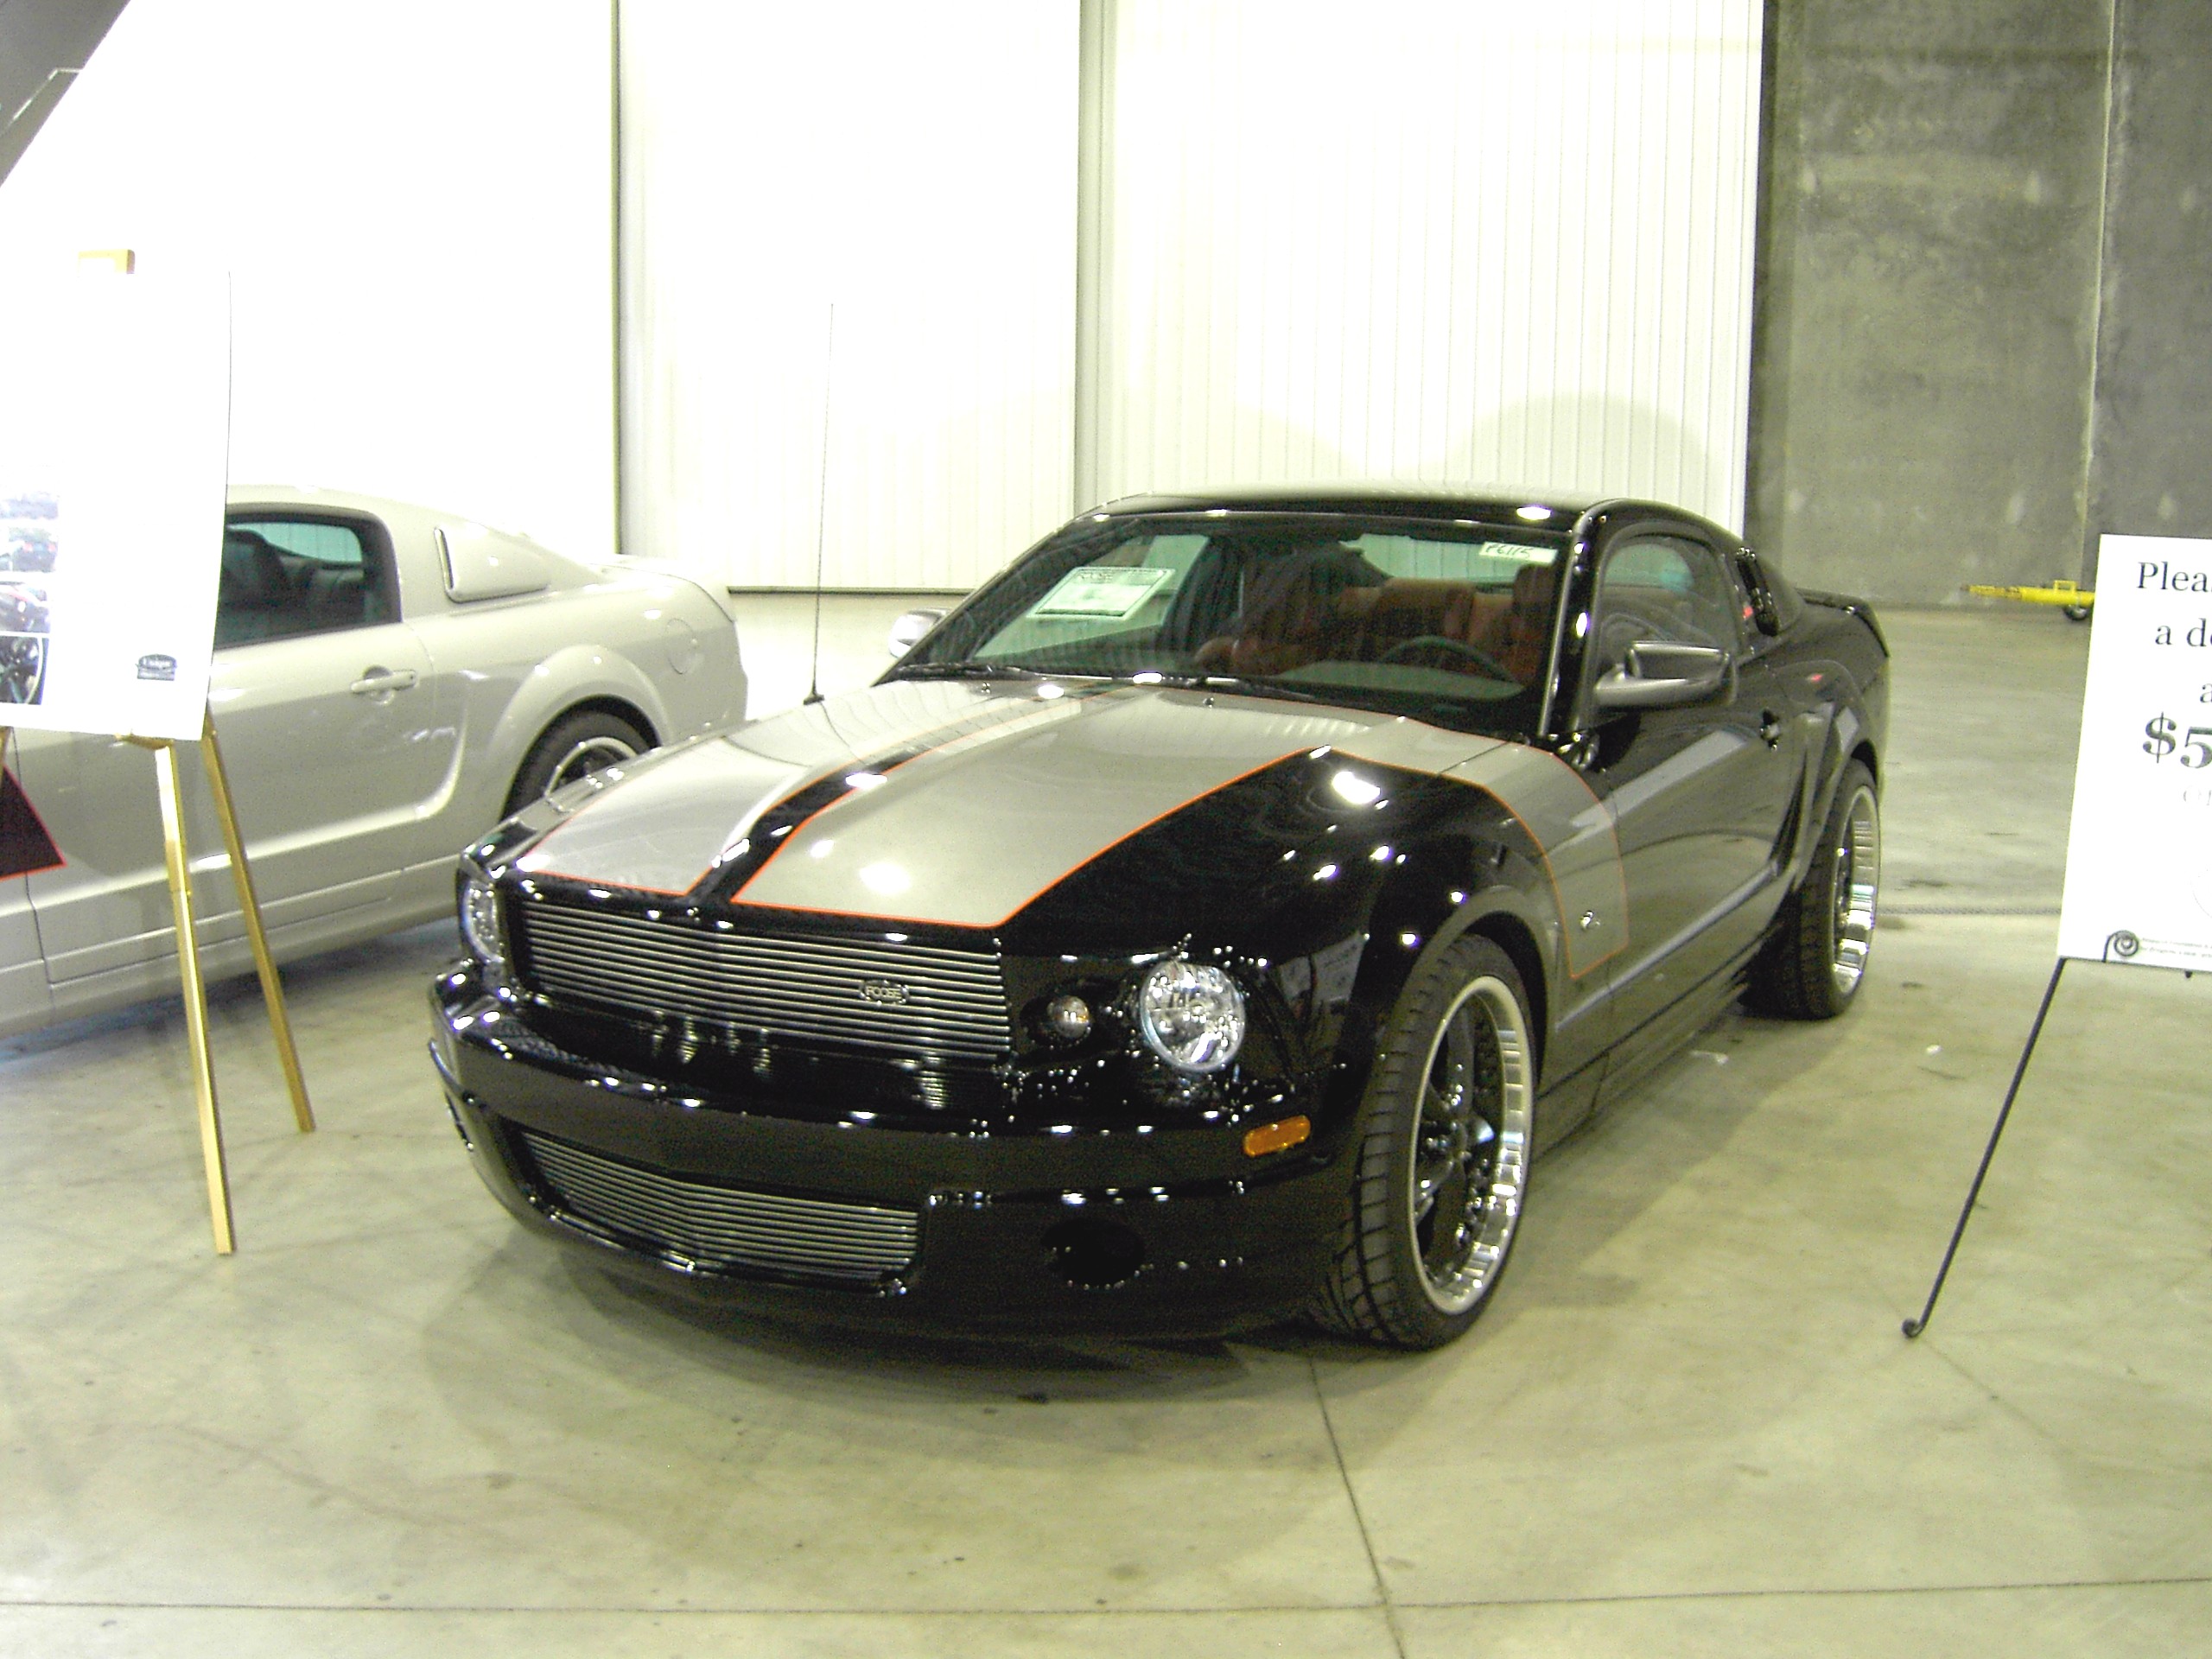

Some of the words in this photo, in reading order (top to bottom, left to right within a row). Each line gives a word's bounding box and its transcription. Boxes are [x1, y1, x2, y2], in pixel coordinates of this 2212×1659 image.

[2136, 560, 2212, 593] Plea
[2155, 625, 2173, 645] a
[2186, 617, 2212, 647] d
